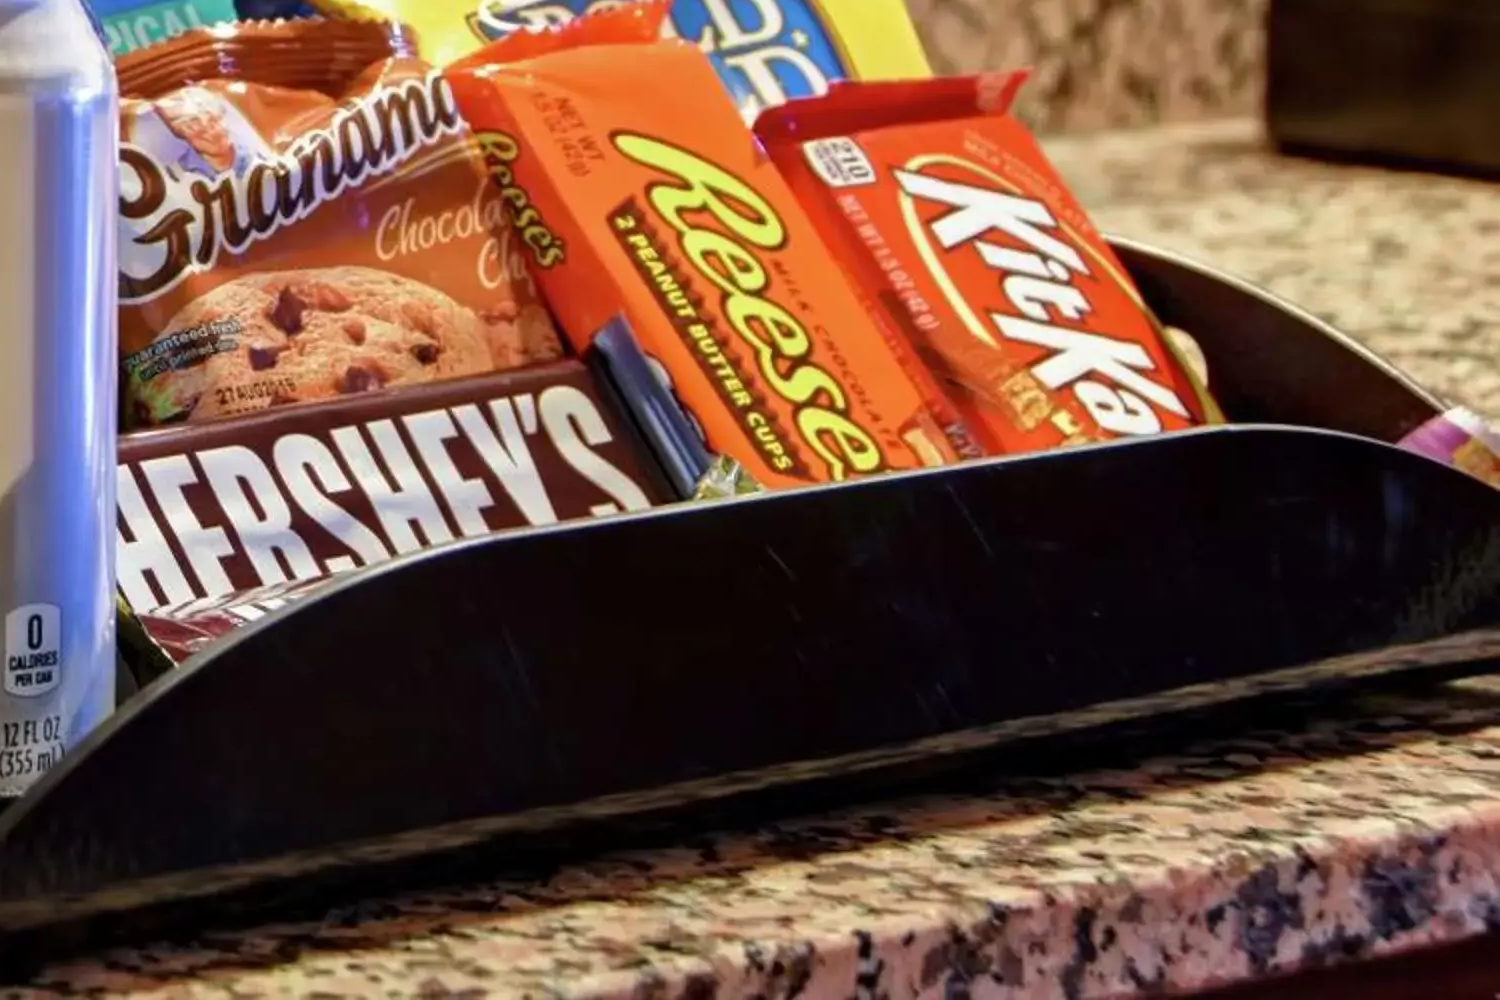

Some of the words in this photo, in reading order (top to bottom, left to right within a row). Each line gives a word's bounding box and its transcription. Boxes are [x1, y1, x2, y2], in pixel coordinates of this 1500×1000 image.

[830, 140, 871, 180] 210
[614, 213, 637, 231] 2
[626, 231, 698, 319] PEANUT
[686, 322, 754, 408] BUTTER
[745, 410, 795, 471] CUPS
[771, 257, 813, 314] MILK
[813, 322, 902, 449] CHOCOLATE
[117, 385, 653, 614] HERSHEY'S
[27, 613, 43, 651] 0
[8, 649, 59, 672] CALORIES
[15, 672, 33, 688] PER
[3, 721, 20, 748] 12
[23, 719, 39, 745] FL
[43, 714, 61, 742] OZ
